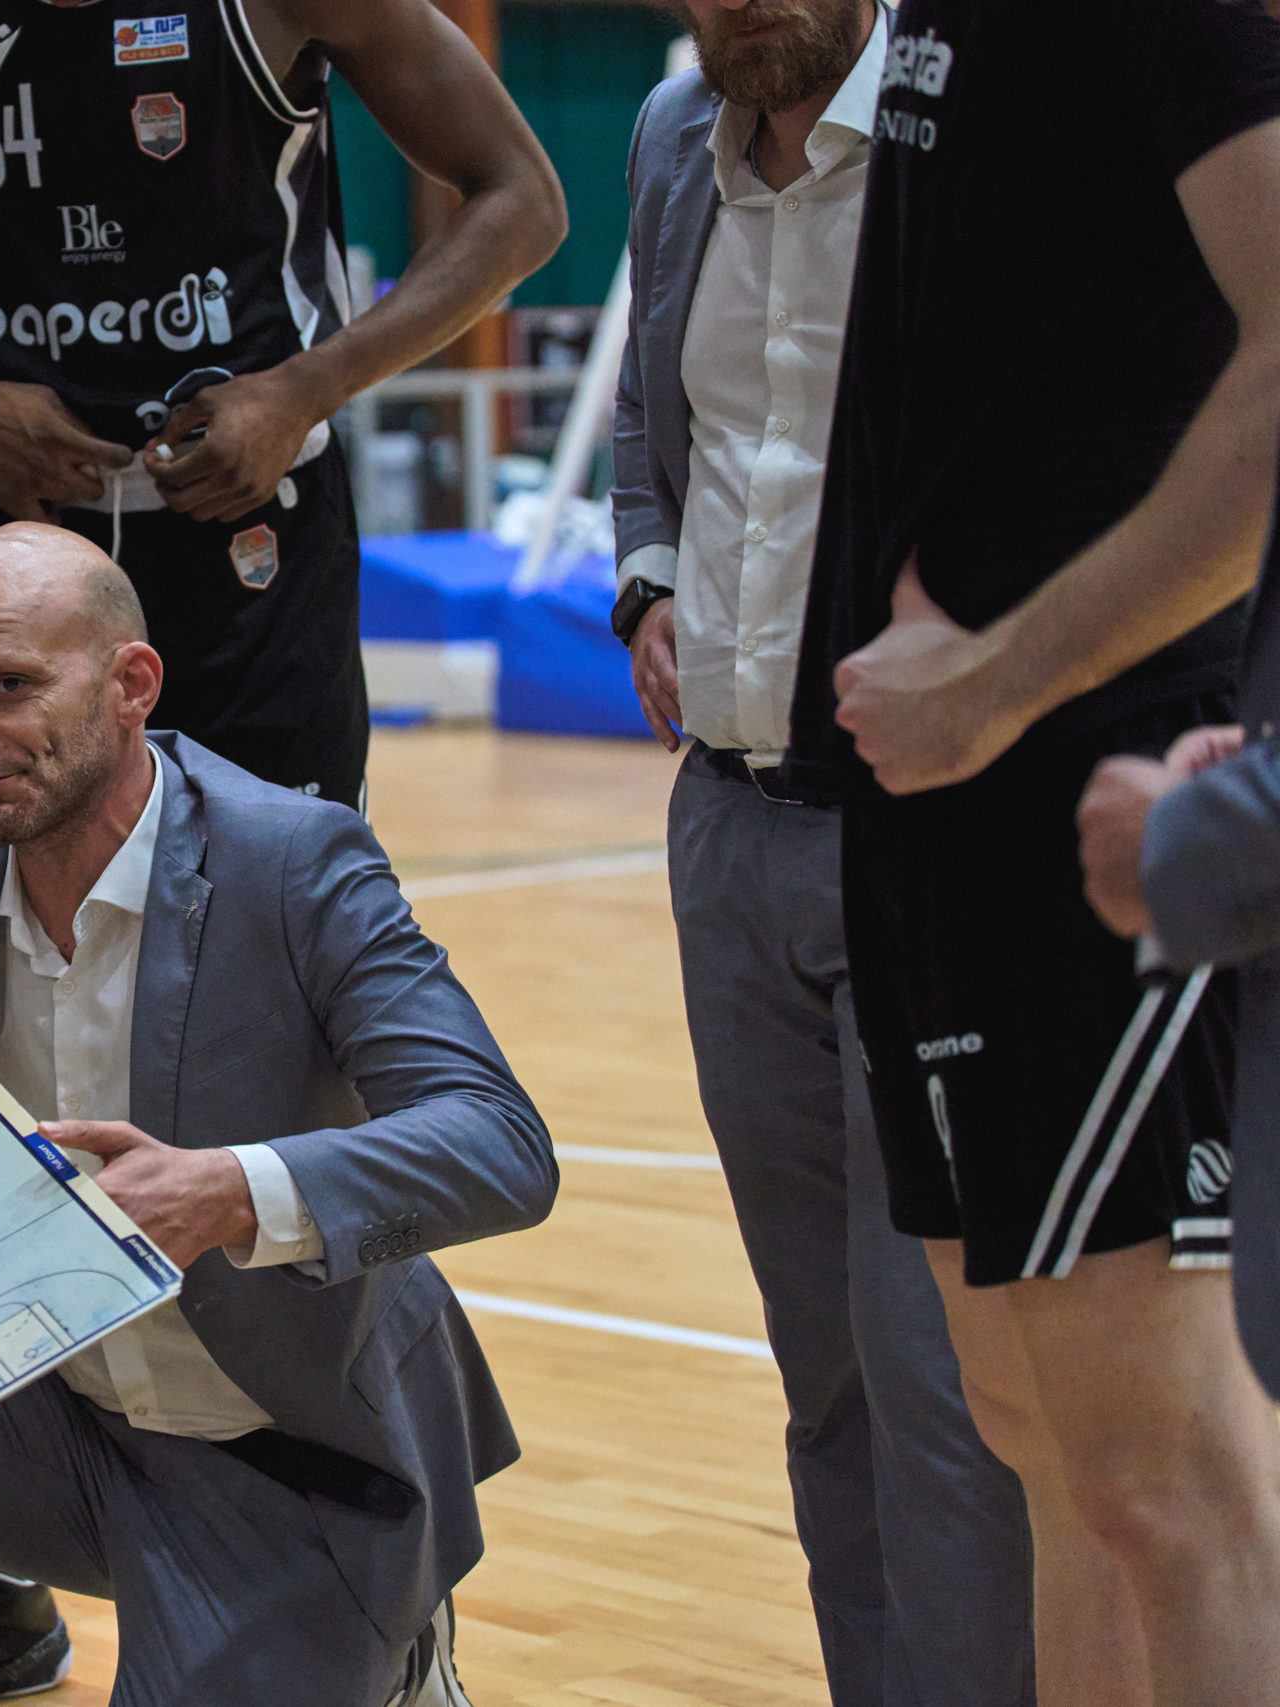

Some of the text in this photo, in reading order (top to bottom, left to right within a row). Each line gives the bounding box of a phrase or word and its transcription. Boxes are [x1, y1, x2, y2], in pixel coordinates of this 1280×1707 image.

[139, 16, 185, 34] LNP
[56, 203, 125, 251] Ble
[60, 250, 126, 266] enjoy energy
